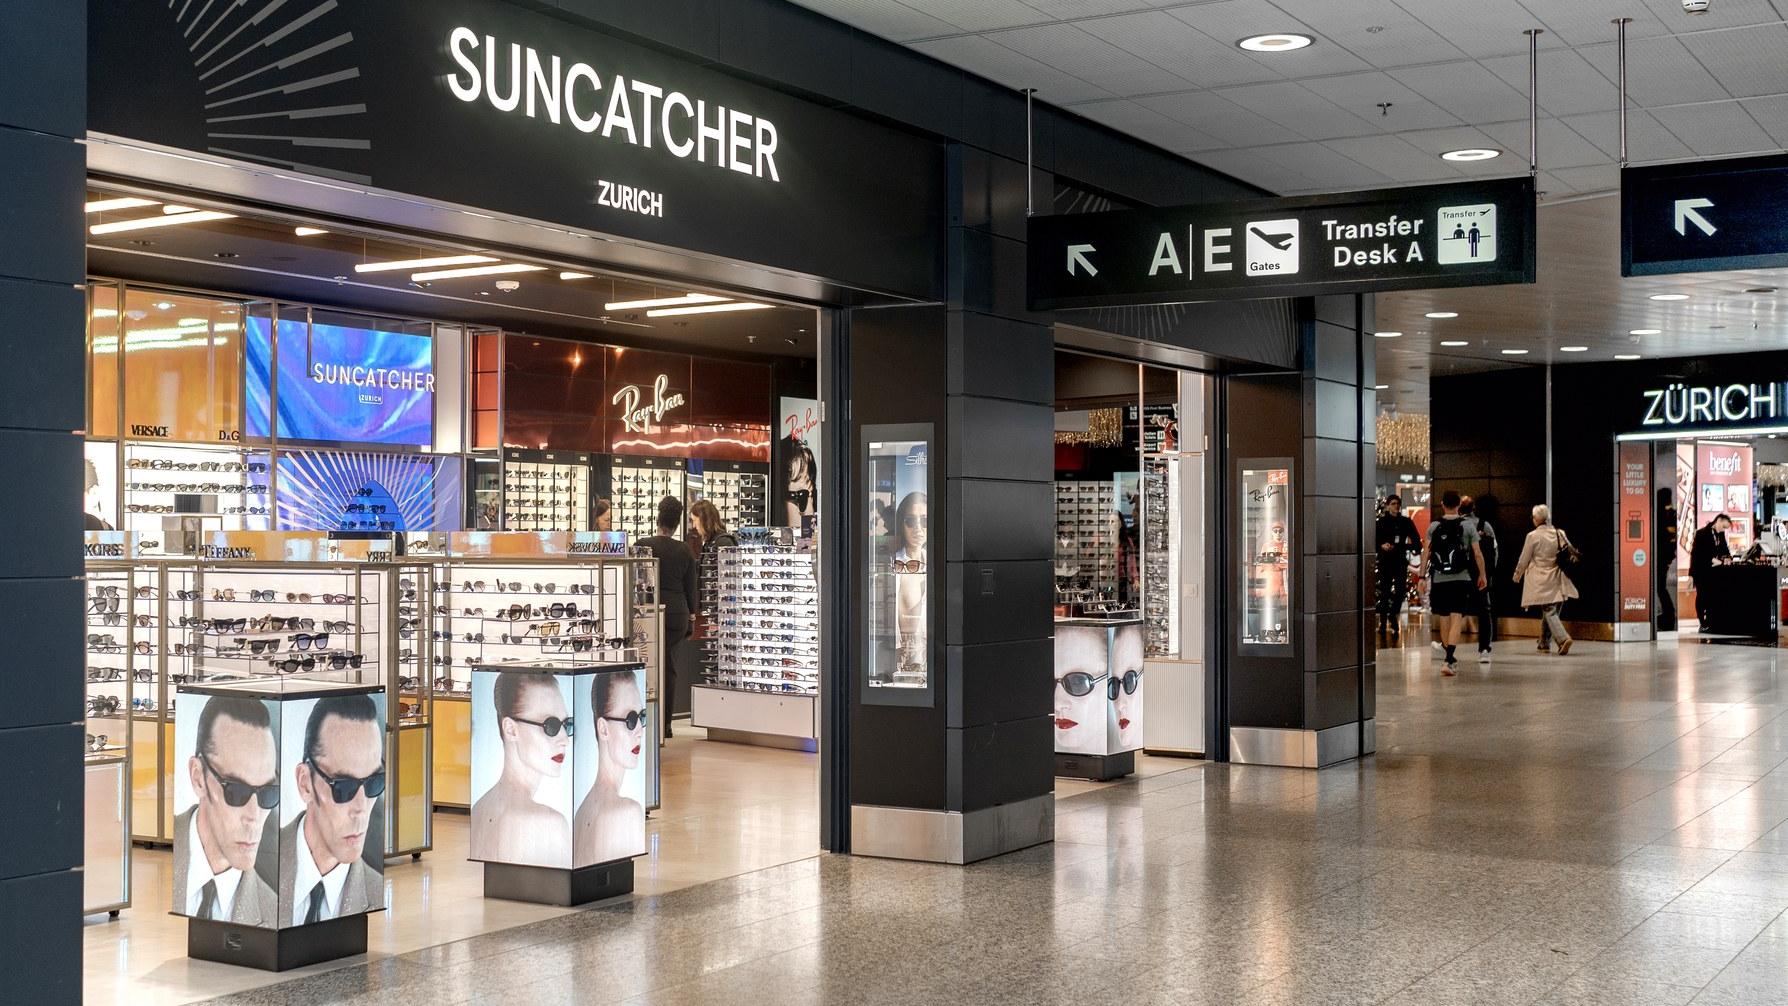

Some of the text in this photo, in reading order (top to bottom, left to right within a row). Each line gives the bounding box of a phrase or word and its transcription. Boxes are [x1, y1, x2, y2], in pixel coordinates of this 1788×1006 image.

[447, 26, 780, 182] SUNCATCHER
[597, 179, 663, 218] ZURICH
[1442, 209, 1477, 219] Transfer
[1322, 215, 1424, 241] Transfer
[1148, 228, 1233, 276] A E
[1334, 241, 1424, 267] Desk A
[1250, 261, 1281, 271] Gates
[313, 362, 435, 393] SUNCATCHER
[361, 394, 382, 402] ZURICH
[1642, 382, 1776, 425] ZÜRICH
[131, 424, 169, 438] VERSACE
[1709, 449, 1742, 477] benefit
